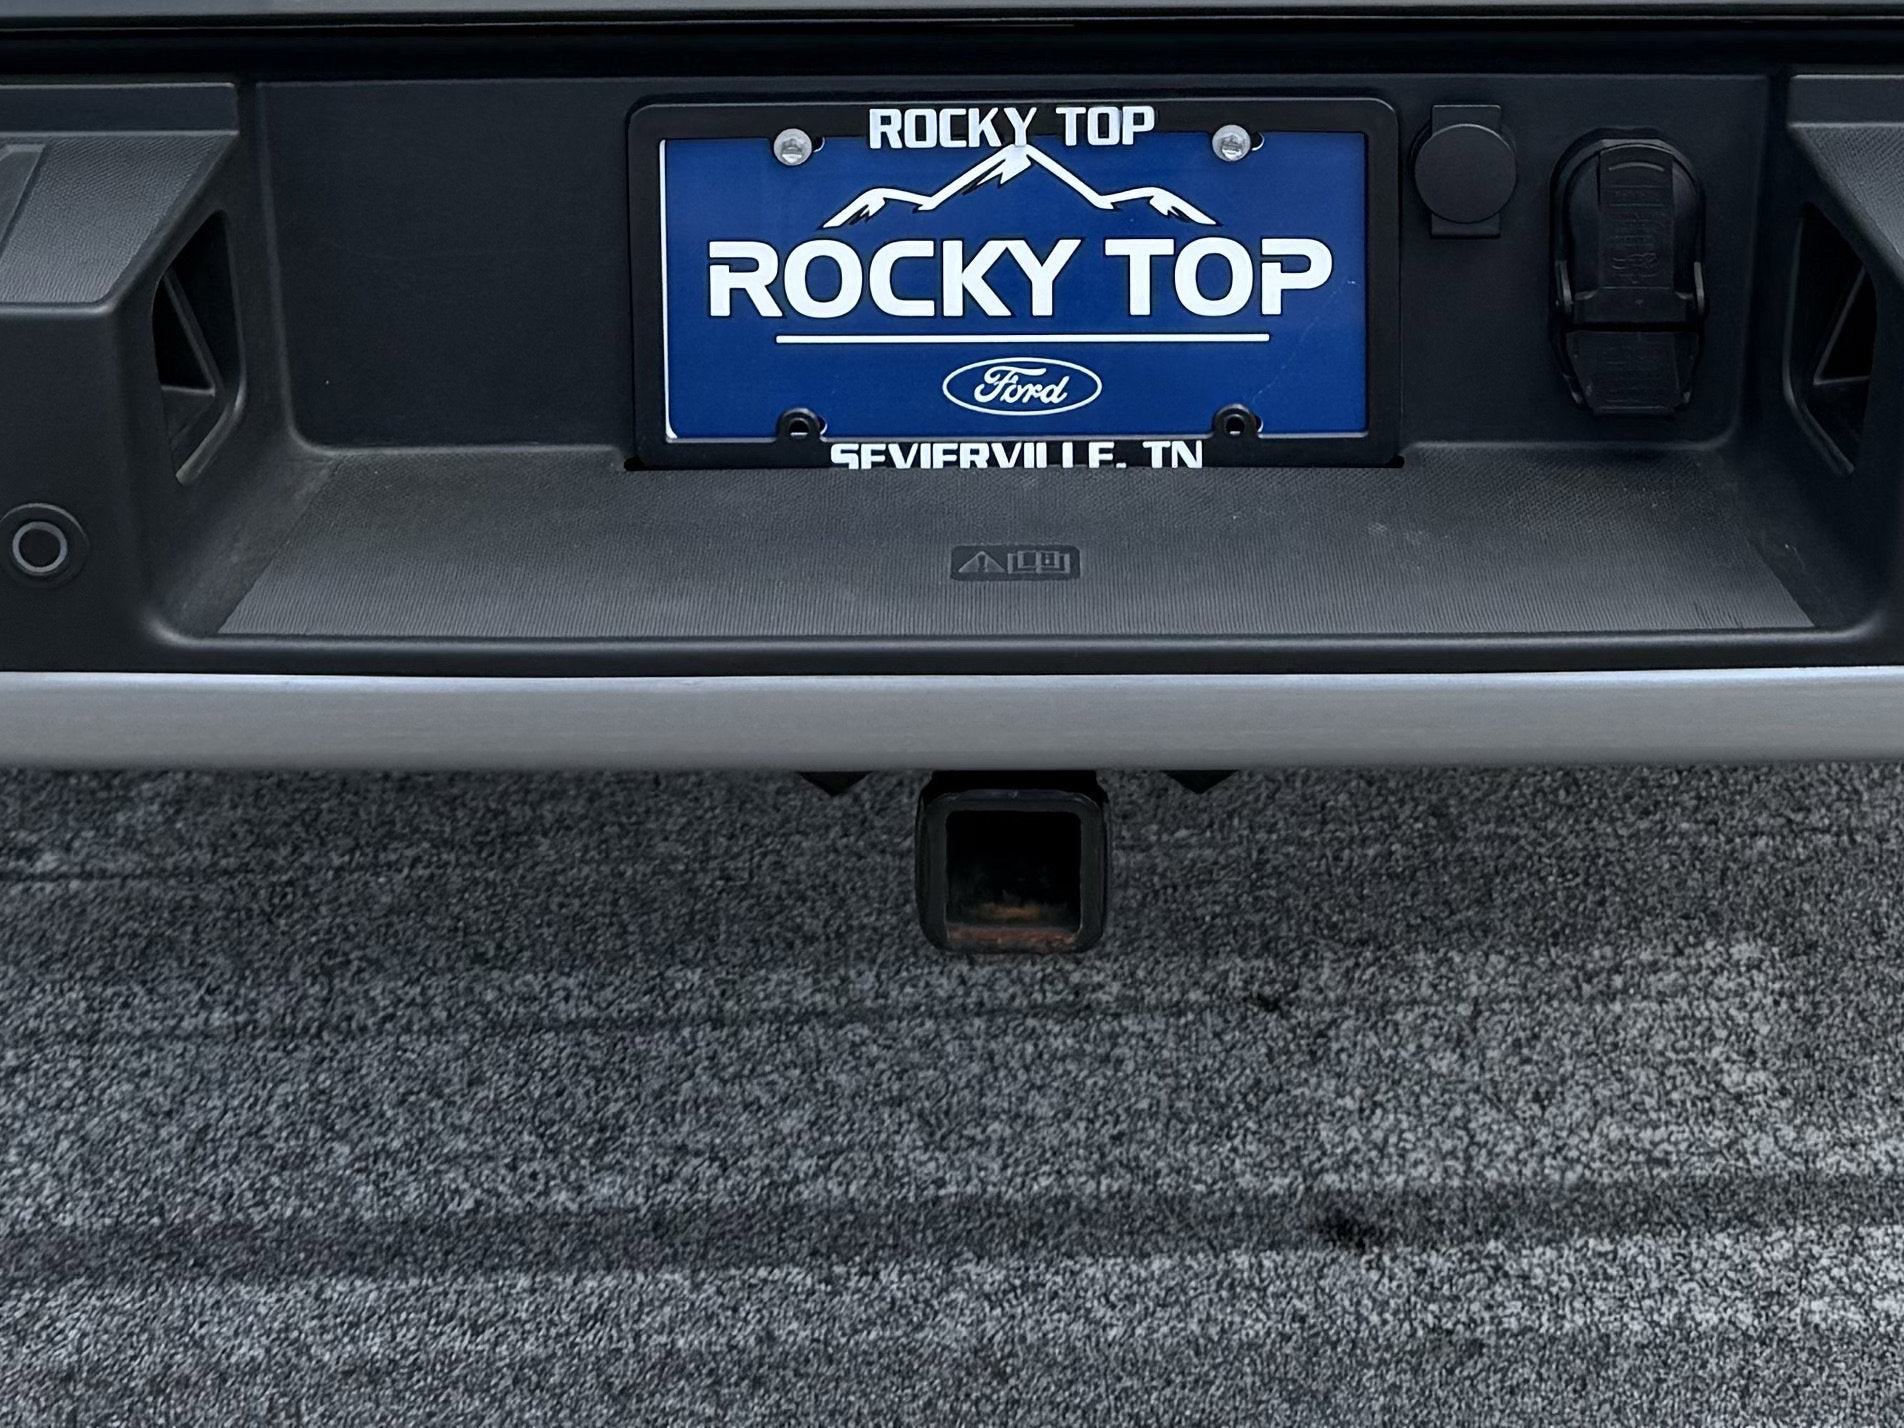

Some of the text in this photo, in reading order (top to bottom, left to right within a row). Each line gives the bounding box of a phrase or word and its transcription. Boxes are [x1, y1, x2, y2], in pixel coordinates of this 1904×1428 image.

[868, 105, 1156, 149] ROCKY TOP
[708, 237, 1334, 319] ROCKY TOP
[972, 364, 1070, 405] Ford
[1142, 440, 1204, 470] TN
